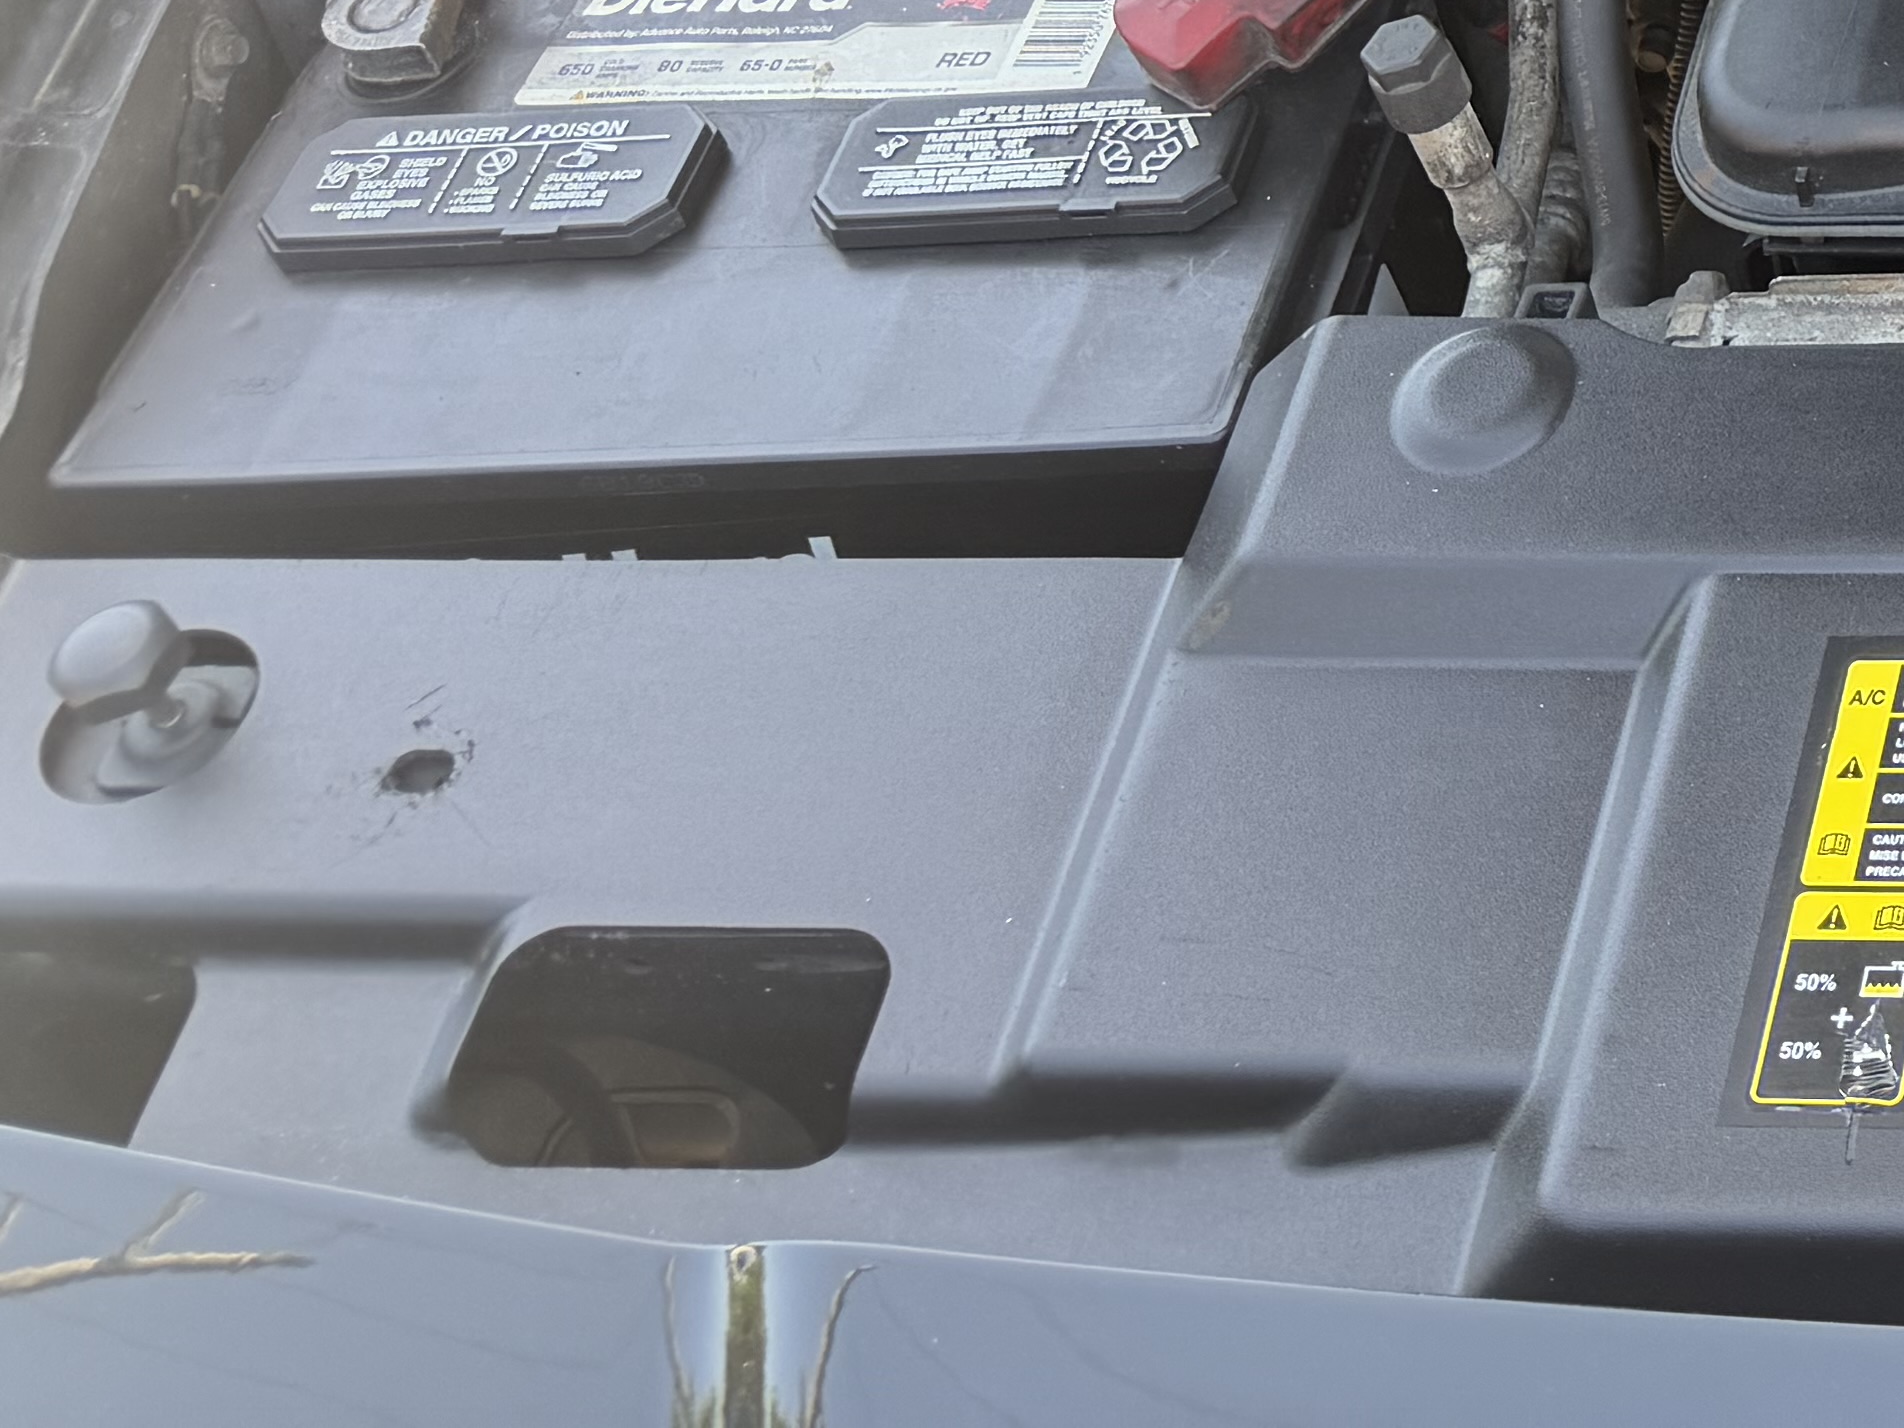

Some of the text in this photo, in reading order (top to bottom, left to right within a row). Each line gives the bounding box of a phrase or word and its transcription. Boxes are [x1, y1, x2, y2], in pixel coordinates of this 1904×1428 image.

[566, 29, 624, 39] Distributed
[641, 27, 682, 37] Advance
[684, 26, 709, 36] Auto
[558, 64, 594, 76] 650
[936, 51, 991, 68] RED
[399, 157, 448, 167] SHIELD
[393, 168, 429, 178] EYES
[544, 169, 643, 183] SULFURIC ACID
[356, 178, 430, 190] EXPLOSIVE
[474, 176, 496, 186] NO
[350, 189, 396, 200] GASES
[1849, 690, 1887, 706] A/C
[1794, 973, 1837, 992] 50%
[1779, 1041, 1822, 1060] 50%
